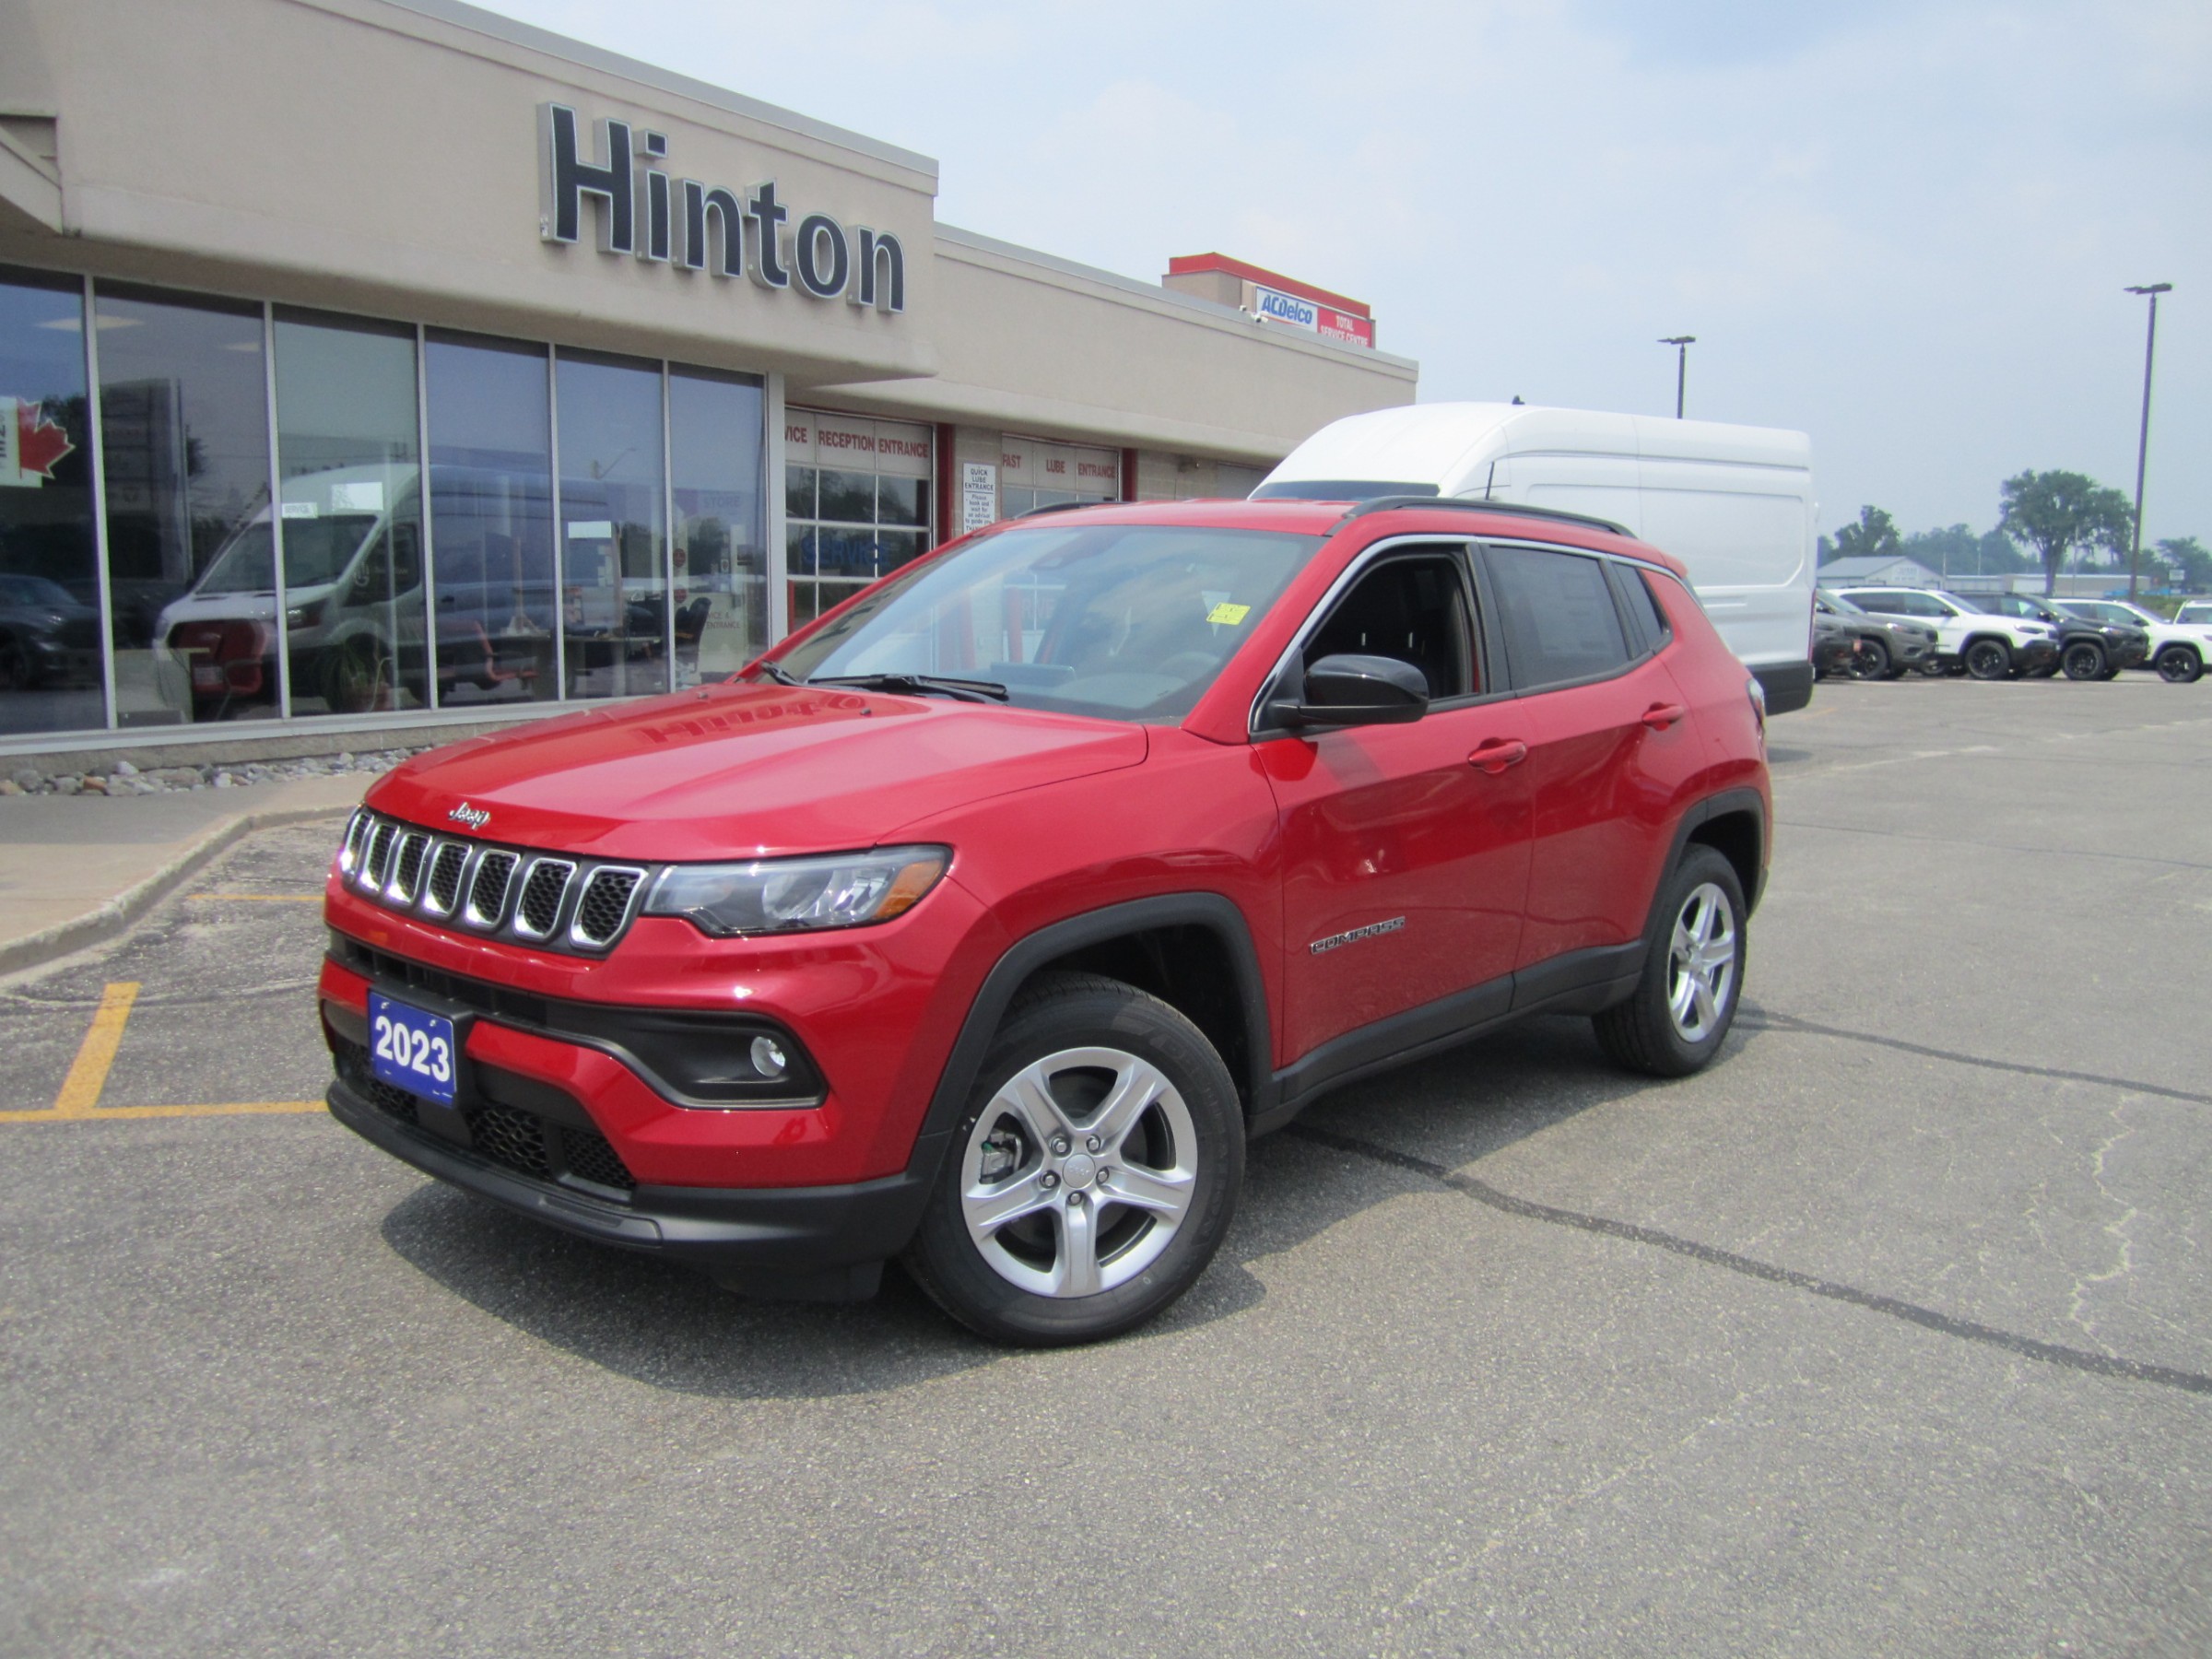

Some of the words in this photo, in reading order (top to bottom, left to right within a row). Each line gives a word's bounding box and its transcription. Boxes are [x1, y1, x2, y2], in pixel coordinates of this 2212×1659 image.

[538, 101, 905, 314] Hinton
[1261, 294, 1312, 324] ACDelco
[1336, 315, 1354, 331] TOTAL
[818, 429, 875, 453] RECEPTION
[878, 437, 928, 459] ENTRANCE
[1002, 453, 1021, 469] FAST
[1046, 458, 1065, 474] LUBE
[1077, 463, 1116, 478] ENTRANCE
[801, 535, 891, 569] SERVICE
[448, 801, 490, 830] Jeep
[1310, 915, 1406, 956] COMPASS
[375, 1015, 451, 1083] 2023
